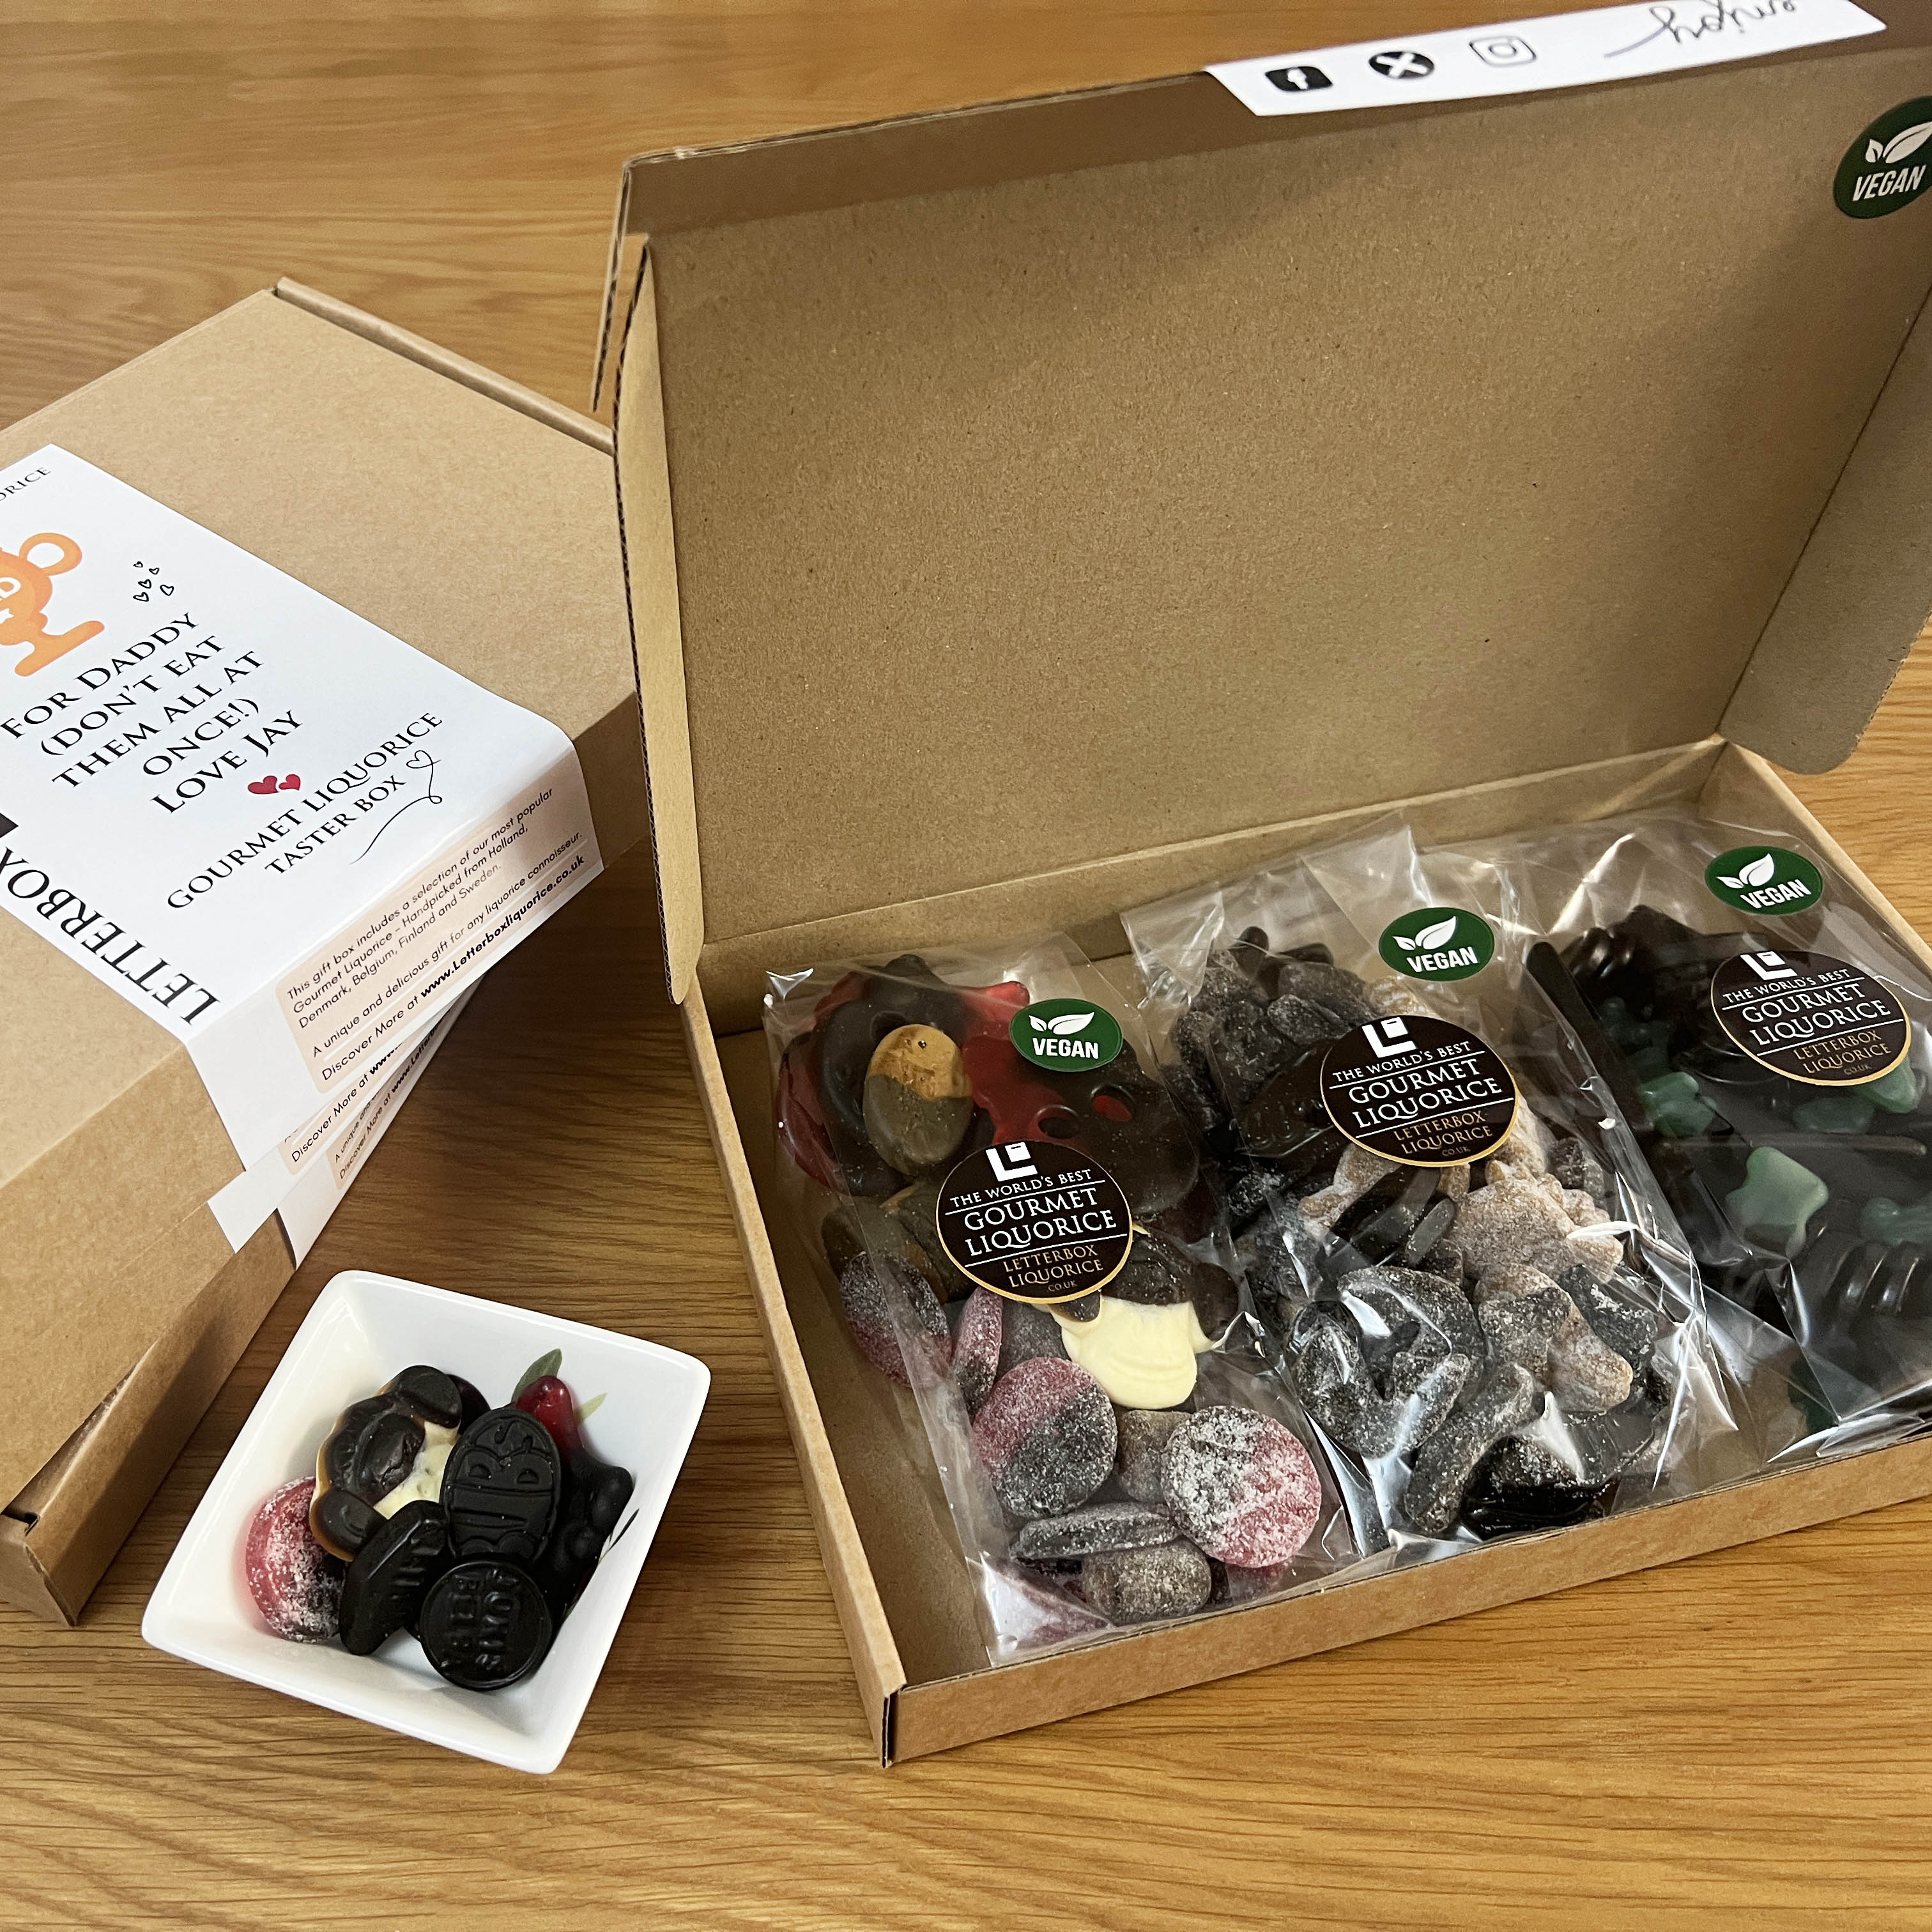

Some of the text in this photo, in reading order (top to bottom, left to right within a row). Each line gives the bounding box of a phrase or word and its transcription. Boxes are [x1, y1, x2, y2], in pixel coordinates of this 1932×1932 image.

[1852, 164, 1927, 202] VEGAN
[1, 612, 199, 739] FOR DADDY
[41, 636, 225, 755] (DON'T EAT
[52, 650, 264, 788] THEM ALL AT
[142, 698, 259, 776] ONCE!)
[150, 710, 303, 813] LOVE JAY
[168, 712, 443, 908] GOURMET LIQUORICE
[264, 775, 406, 874] TASTER BOX
[287, 981, 310, 1000] This
[312, 962, 331, 984] gift
[334, 945, 355, 964] box
[356, 909, 400, 946] includes
[412, 864, 457, 903] selection
[460, 851, 470, 864] of
[473, 839, 488, 855] our
[491, 818, 514, 841] most
[517, 788, 552, 823] popular
[1740, 879, 1812, 908] VEGAN
[293, 970, 342, 1013] Gourmet
[344, 933, 392, 974] Liquorice
[402, 877, 461, 928] Handpicked
[464, 857, 487, 878] from
[488, 824, 528, 858] Holland,
[299, 865, 501, 1028] Denmark, Belgium, Finland and Sweden.
[312, 831, 582, 1058] A unique and delicious gift for any liquorice connoisseur.
[321, 1036, 373, 1080] Discover
[375, 1009, 404, 1038] More
[407, 995, 419, 1009] at
[420, 855, 584, 998] www.Letterboxliquorice.co.uk
[1406, 946, 1479, 972] VEGAN
[1723, 969, 1850, 1003] THE WORLD'S BEST
[1742, 983, 1866, 1022] GOURMET
[1749, 1000, 1891, 1046] LIQUORICE
[1793, 1030, 1882, 1060] LETTERBOX
[1032, 1038, 1099, 1059] VEGAN
[1332, 1041, 1472, 1082] THE WORLD'S BEST
[1803, 1043, 1891, 1074] LIQUORICE
[1349, 1058, 1482, 1104] GOURMET
[1353, 1077, 1502, 1128] LIQUORICE
[291, 1116, 332, 1162] Discover
[334, 1089, 357, 1117] More
[359, 1074, 369, 1088] at
[340, 1135, 366, 1179] Discover
[367, 1107, 382, 1135] More
[384, 1093, 391, 1106] at
[1393, 1110, 1487, 1140] LETTERBOX
[1401, 1126, 1492, 1154] LIQUORICE
[335, 1154, 340, 1163] A
[341, 1122, 359, 1154] unique
[950, 1169, 1091, 1208] THE WORLD'S BEST
[964, 1187, 1098, 1231] GOURMET
[965, 1209, 1117, 1256] LIQUORICE
[1002, 1245, 1099, 1272] LETTERBOX
[1008, 1259, 1104, 1288] LIQUORICE
